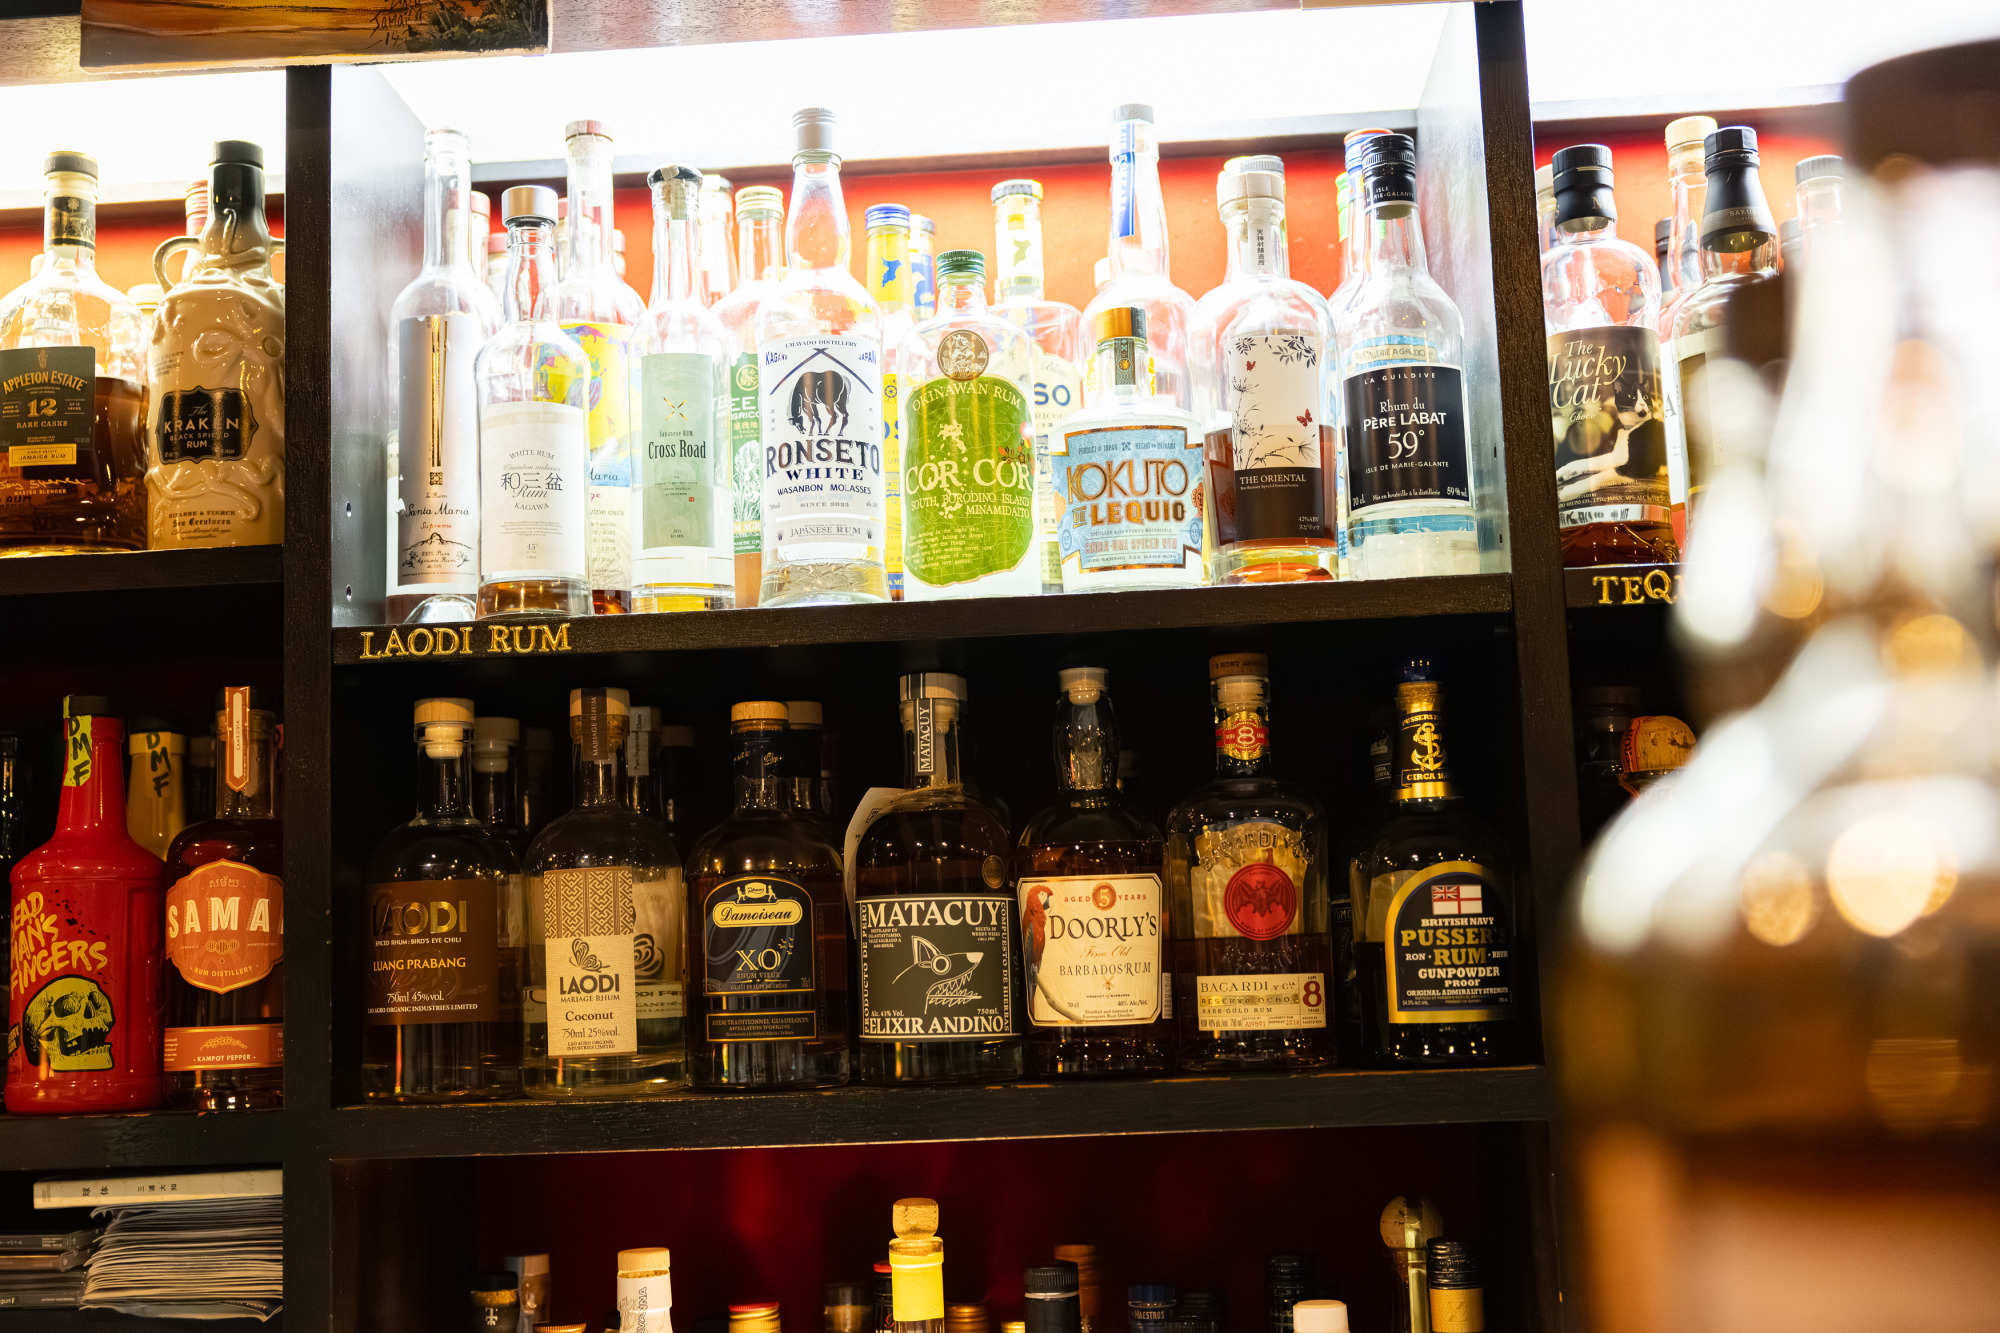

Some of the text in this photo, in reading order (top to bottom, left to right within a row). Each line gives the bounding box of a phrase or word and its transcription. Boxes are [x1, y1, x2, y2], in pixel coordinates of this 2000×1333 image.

[1375, 185, 1389, 193] ISLE
[785, 339, 858, 349] UMAYADO DISTILLERY
[1564, 339, 1594, 357] The
[765, 350, 788, 366] KAGAWA
[858, 349, 877, 364] JAPAN
[1550, 345, 1627, 386] Lucky
[3, 369, 84, 395] APPLETON ESTATE
[1364, 372, 1436, 385] LA GUILDIVE
[912, 382, 1022, 412] OKINAWAN RUM
[1552, 376, 1603, 410] Cat
[28, 397, 58, 418] 12
[1379, 397, 1426, 413] Rhum du
[1363, 412, 1447, 432] PÈRE LABAT
[1569, 410, 1597, 424] Choco
[16, 421, 39, 429] RARE
[169, 431, 194, 442] BLACK
[186, 439, 208, 449] RUM
[648, 438, 707, 460] Cross Road
[1388, 429, 1426, 460] 59°
[509, 449, 555, 461] WHITE RUM
[765, 438, 880, 479] RONSETO
[786, 467, 864, 481] WHITE
[1365, 466, 1378, 474] ISLE
[1391, 460, 1450, 469] MARIE-GALANTE
[501, 472, 563, 491] 和三盆
[905, 458, 1033, 496] COR COR
[1066, 458, 1190, 504] KOKUTO
[1239, 473, 1307, 485] THE ORIENTAL
[512, 484, 548, 499] Rum
[777, 483, 872, 496] WASANBON MOLASSES
[514, 501, 550, 511] KAGAWA
[941, 492, 997, 506] BORODINO
[1001, 493, 1030, 507] ISLAND
[405, 502, 471, 518] Santa Maria
[965, 503, 1030, 519] MINAMIDAITO
[1073, 499, 1186, 526] DE LEQUIO
[420, 522, 452, 532] Supreme
[790, 525, 861, 537] JAPANESE RUM
[1130, 538, 1160, 551] SPICED
[1161, 537, 1178, 550] RUM
[360, 622, 572, 660] LAODI RUM
[590, 696, 599, 757] MARIAGE RHUM
[919, 706, 931, 770] MATACUY
[1237, 726, 1256, 745] 8
[1406, 772, 1437, 781] CIRCA
[1063, 888, 1147, 908] AGED 5 YEARS
[373, 899, 468, 938] LAODI
[720, 905, 793, 922] Damoiseau
[866, 900, 1002, 928] MATACUY
[1048, 911, 1158, 942] DOORLY'S
[1420, 916, 1495, 928] BRITISH NAVY
[410, 937, 430, 945] BIRD'S
[862, 941, 869, 959] DE
[1111, 944, 1133, 957] Old
[1405, 947, 1509, 966] RON RUM RHUM
[373, 957, 467, 972] LUANG PRABANG
[735, 948, 782, 971] XO
[1000, 901, 1010, 1032] COMPUESTO DE HIERBAS
[10, 939, 109, 1001] FINGERS
[194, 964, 253, 977] RUM DISTILLERY
[1059, 961, 1151, 977] BARBADOS RUM
[1418, 966, 1501, 980] GUNPOWDER
[559, 973, 620, 996] LAODI
[1200, 981, 1268, 993] BACARDI
[1444, 978, 1481, 988] PROOF
[387, 991, 409, 1004] 750ml
[560, 993, 621, 1003] MARIAGE RHUM
[862, 962, 870, 1034] PRODUCTO
[1302, 980, 1323, 1008] 8
[1406, 989, 1441, 997] ORIGINAL
[1441, 987, 1482, 996] ADMIRALTY
[386, 1003, 478, 1013] ORGANIC INDUSTRIES LIMITED
[1201, 996, 1291, 1006] RESERVA OCHO
[565, 1010, 614, 1022] Coconut
[892, 1009, 905, 1017] Vol.
[869, 1015, 1004, 1035] ELIXIR ANDINO
[562, 1027, 586, 1039] 750ml
[197, 1053, 252, 1063] KAMPOT PEPPER
[1134, 1309, 1165, 1321] MAESTROS
